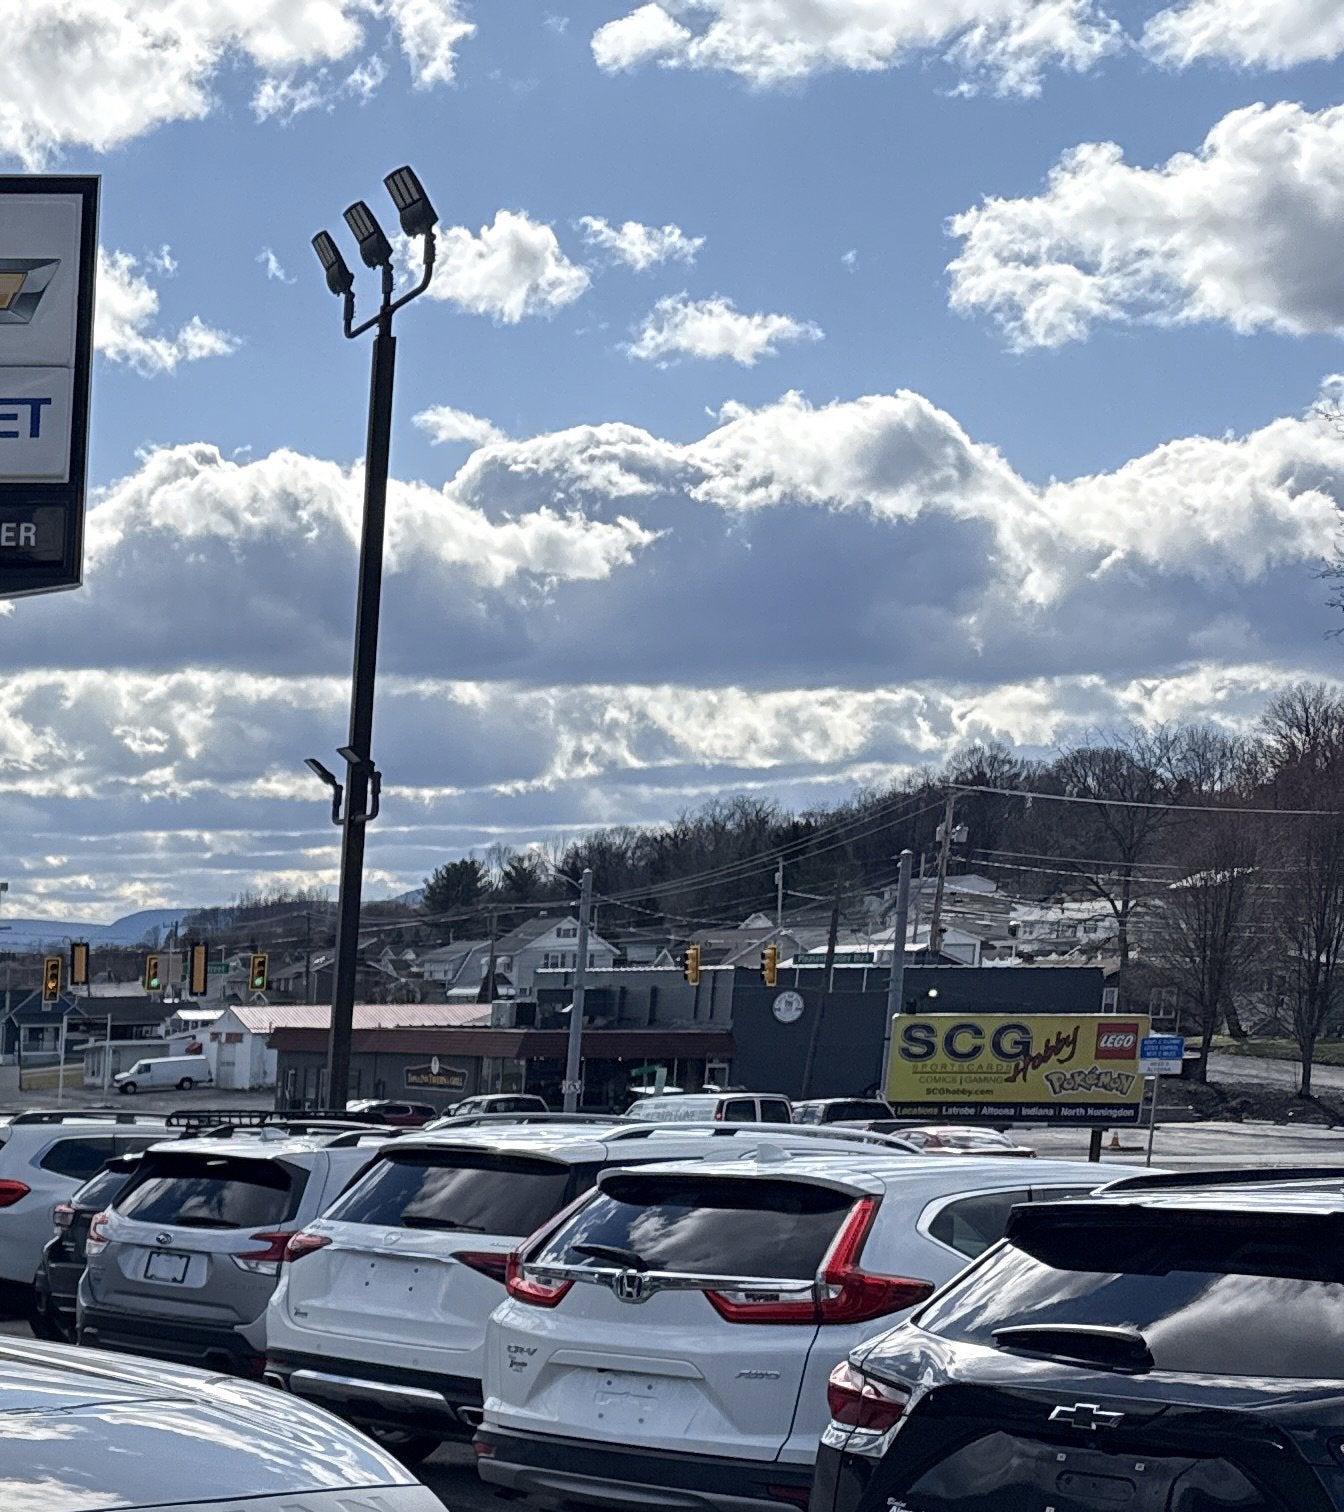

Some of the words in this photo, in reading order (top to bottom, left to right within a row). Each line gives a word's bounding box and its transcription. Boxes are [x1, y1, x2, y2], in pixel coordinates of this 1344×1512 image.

[898, 1022, 1033, 1062] SCG
[1099, 1033, 1135, 1048] LEGO
[1004, 1025, 1080, 1083] Hobby
[918, 1075, 957, 1084] COMICS
[942, 1106, 976, 1115] Latrobe
[981, 1106, 1015, 1115] Altoona
[1021, 1107, 1054, 1116] Indiana
[1061, 1107, 1086, 1116] North
